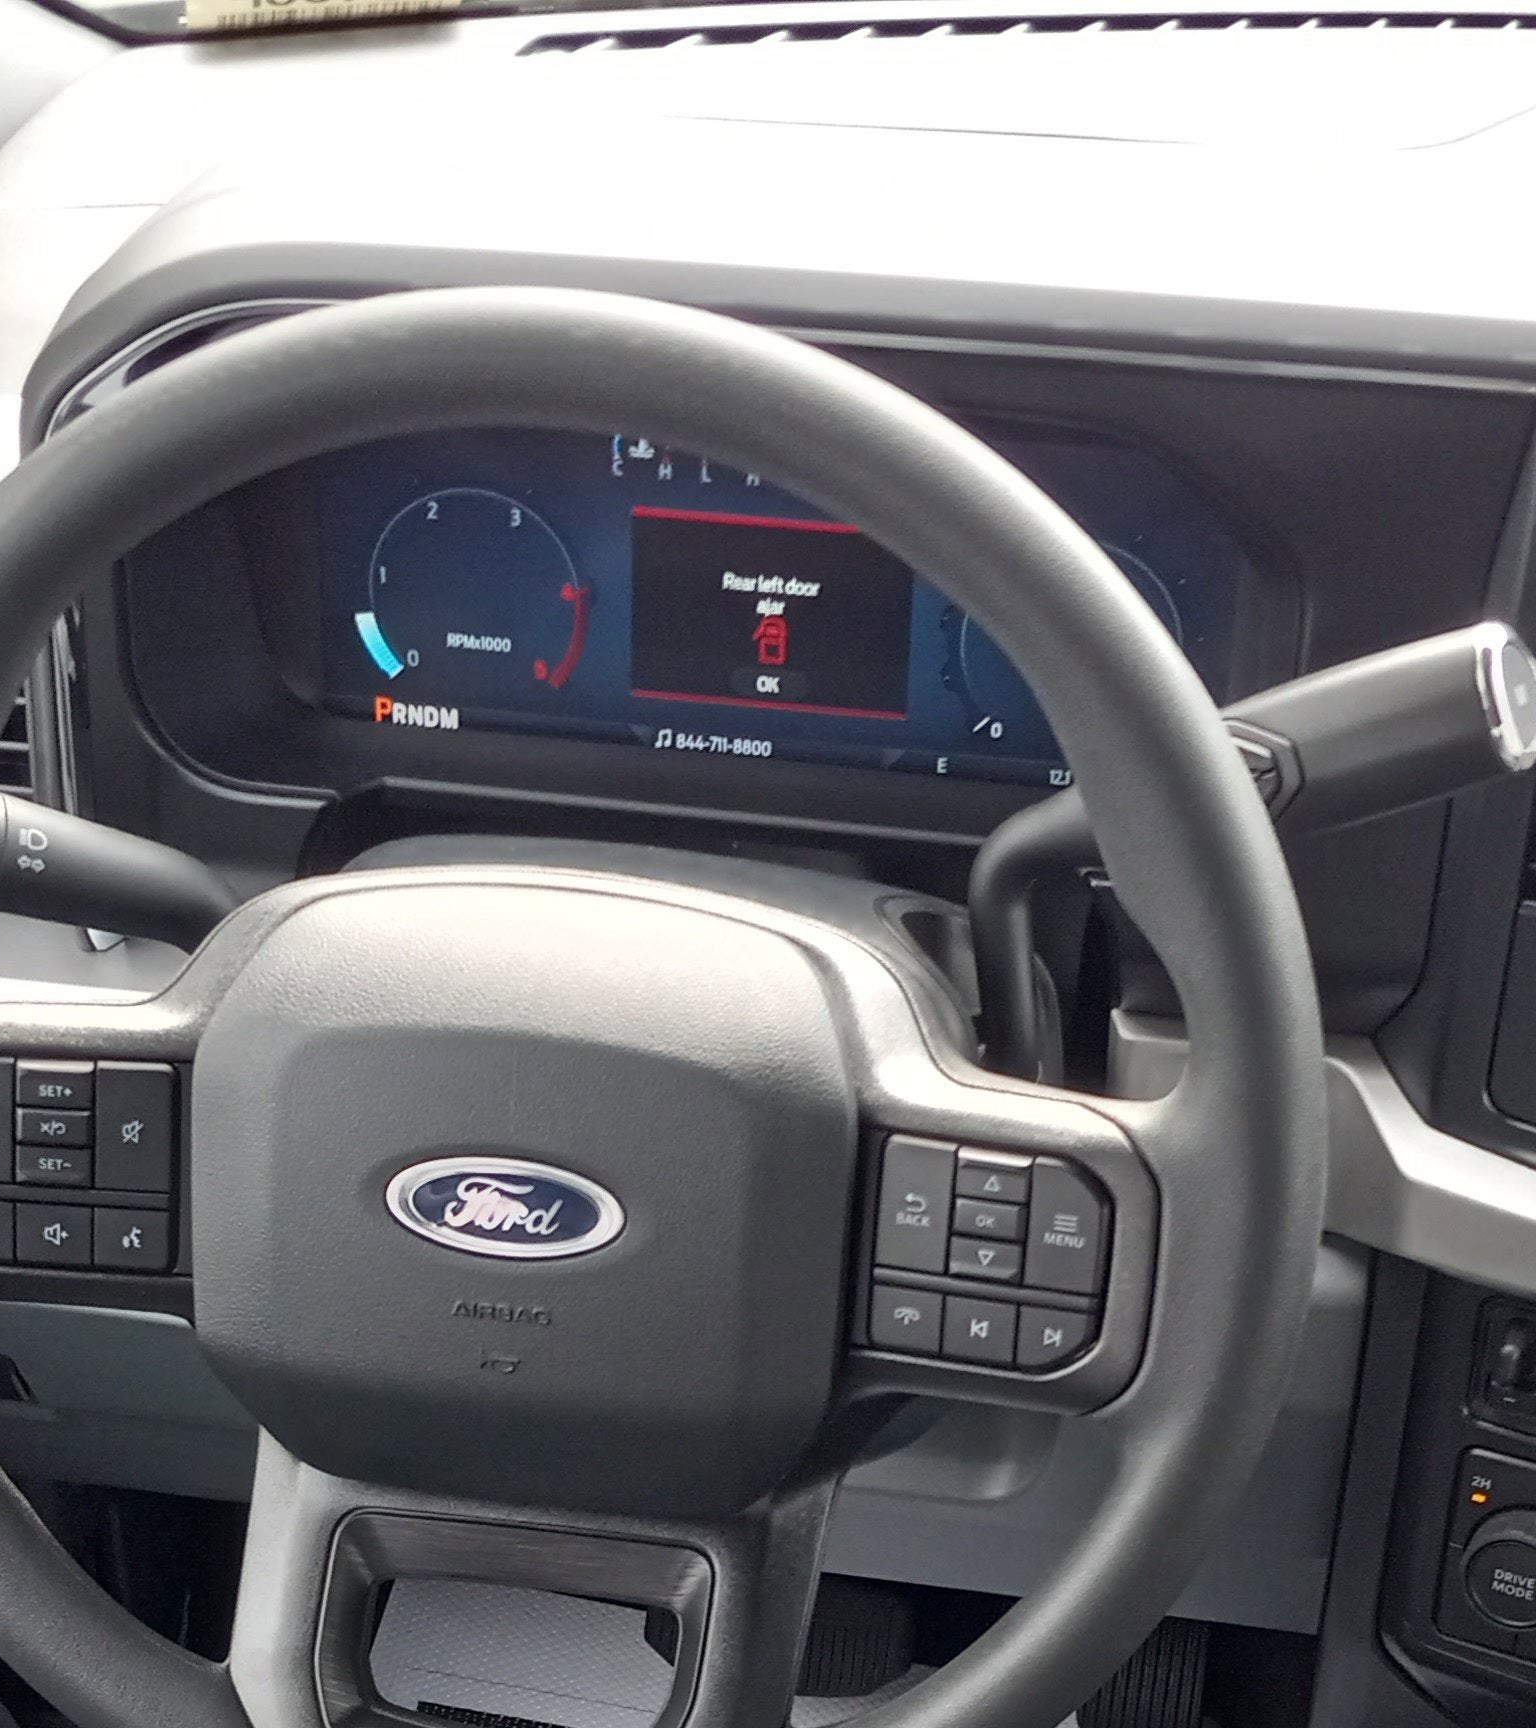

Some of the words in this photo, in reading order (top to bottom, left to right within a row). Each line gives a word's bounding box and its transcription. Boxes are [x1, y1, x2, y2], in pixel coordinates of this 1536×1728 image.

[426, 501, 439, 521] 2
[510, 508, 522, 528] 3
[378, 565, 386, 584] 1
[722, 571, 757, 592] Rear
[757, 574, 785, 594] left
[784, 576, 821, 598] door
[756, 597, 787, 617] ajar
[446, 631, 512, 653] RPMx1000
[406, 649, 420, 667] 0
[756, 675, 781, 694] OK
[990, 722, 1003, 739] 0
[675, 732, 773, 757] 844-711-8800
[936, 757, 949, 775] E
[441, 1176, 564, 1237] Ford
[895, 1212, 931, 1228] BACK
[975, 1215, 996, 1229] OK
[1042, 1232, 1087, 1249] MENU
[450, 1300, 552, 1326] AIRBAG
[1470, 1475, 1492, 1491] 2H
[1493, 1568, 1536, 1590] DRIVE
[1491, 1580, 1536, 1601] MODE
